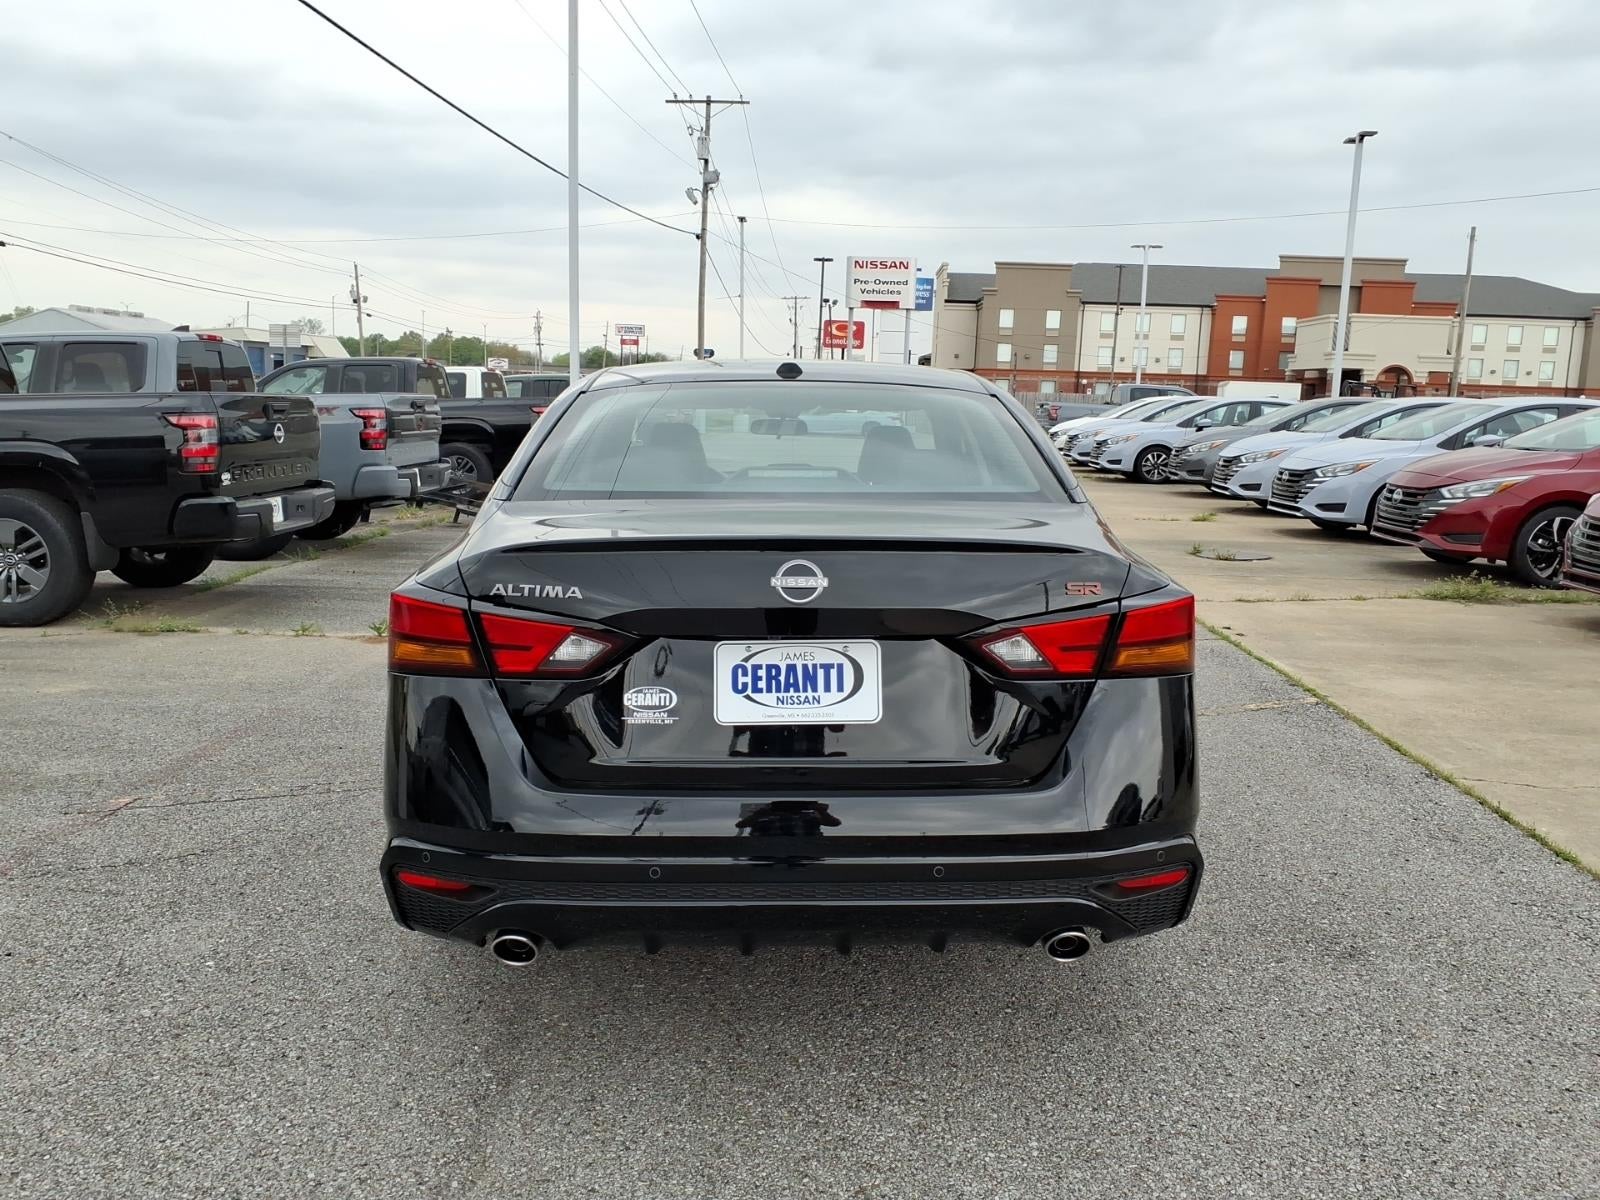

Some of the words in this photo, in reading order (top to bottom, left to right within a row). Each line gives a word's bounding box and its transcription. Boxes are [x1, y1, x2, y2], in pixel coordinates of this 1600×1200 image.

[854, 260, 909, 270] NISSAN
[853, 278, 909, 286] Pre-Owned
[859, 288, 902, 296] Vehicles
[771, 578, 828, 587] NISSAN
[489, 583, 583, 599] ALTIMA
[1065, 582, 1103, 596] SR
[779, 651, 816, 662] JAMES
[731, 662, 845, 695] CERANTI
[623, 692, 670, 706] CERANTI
[776, 695, 821, 706] NISSAN
